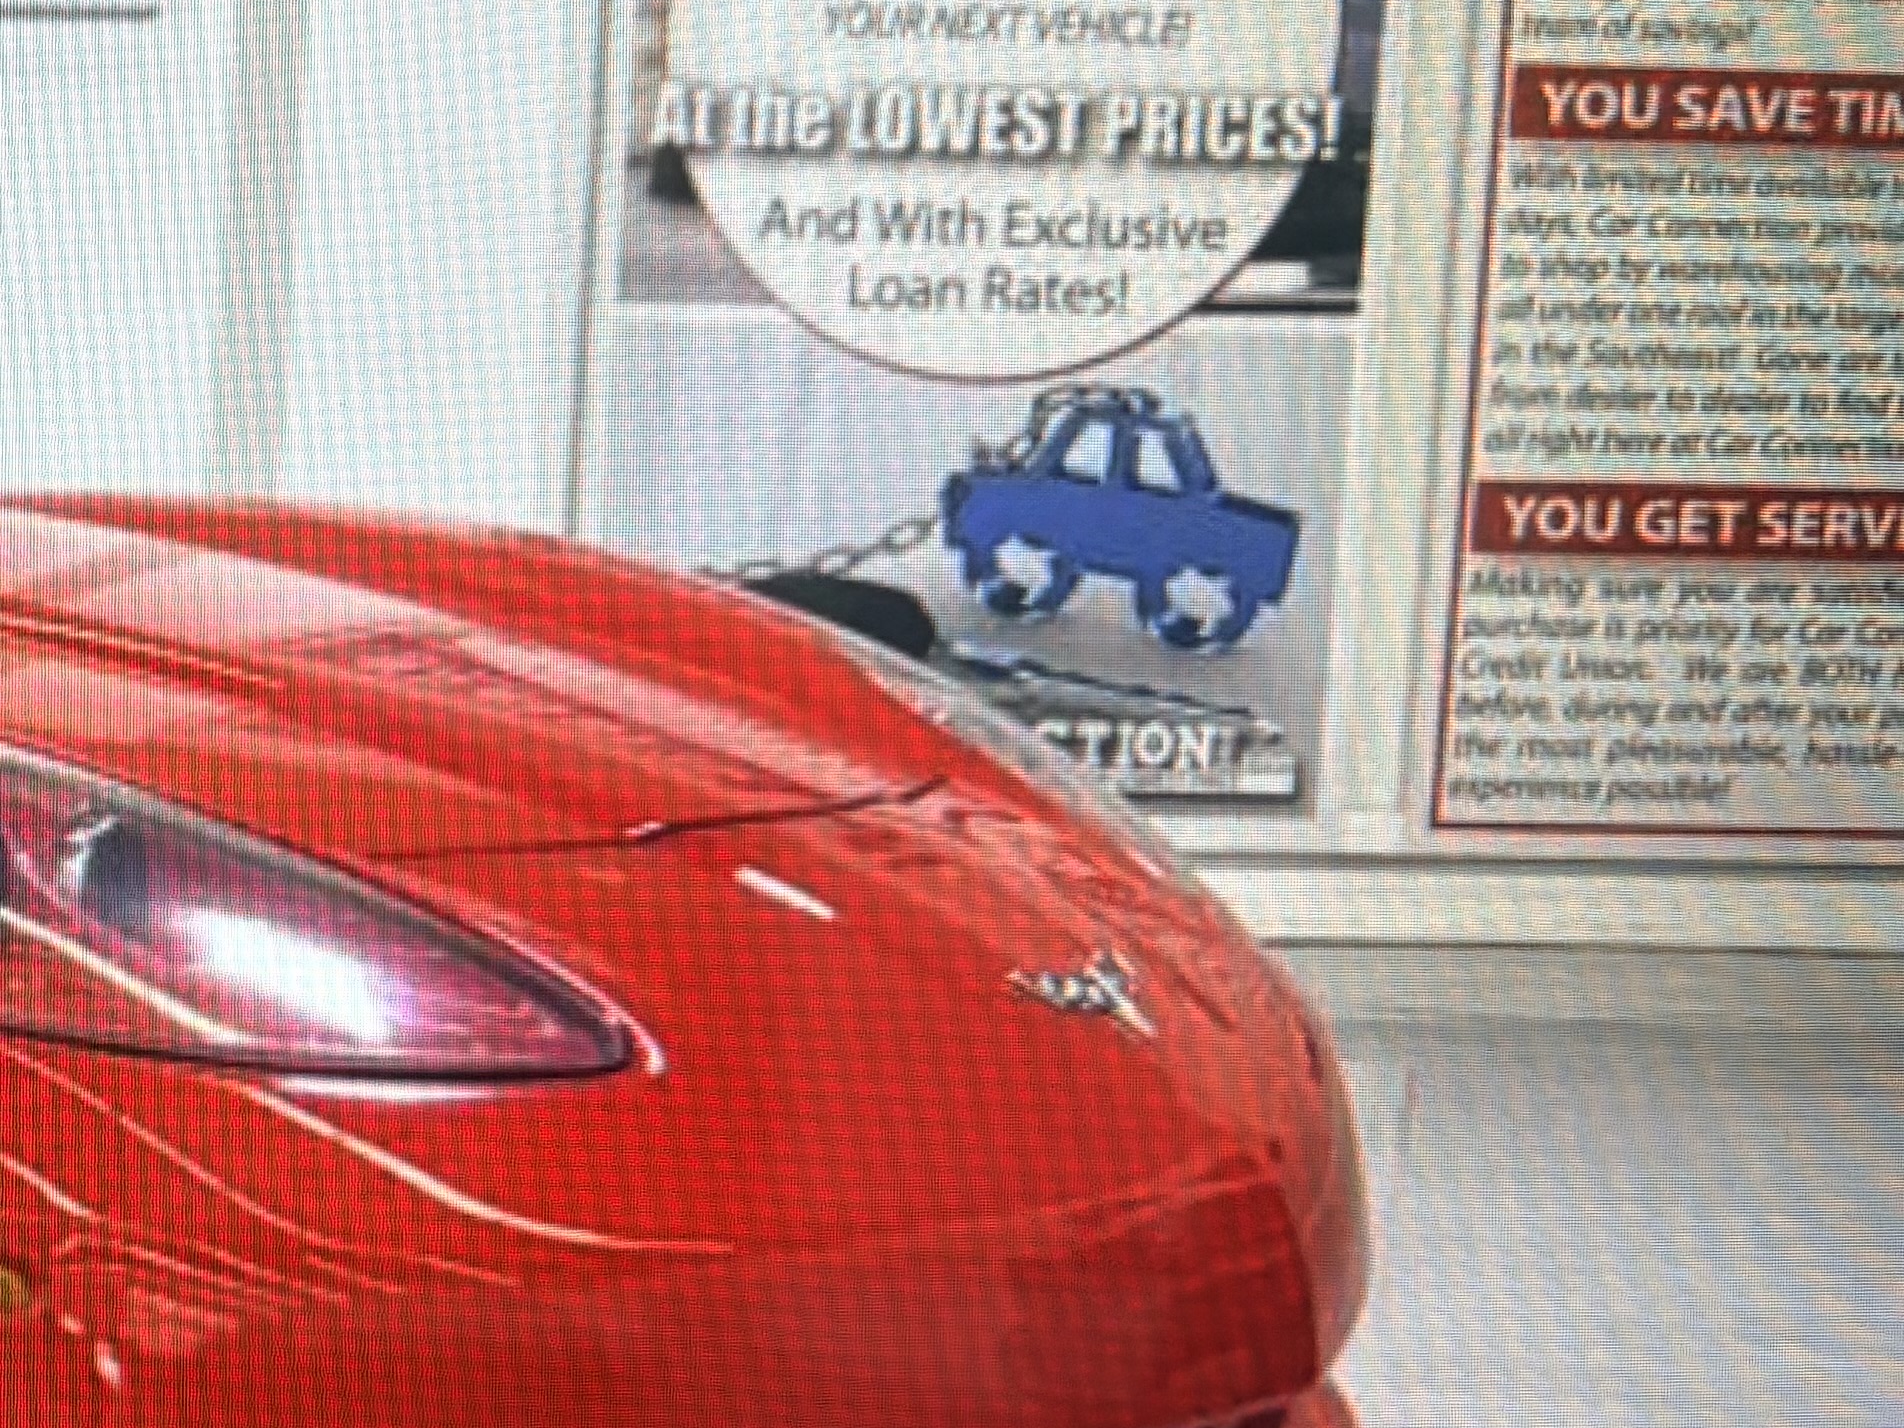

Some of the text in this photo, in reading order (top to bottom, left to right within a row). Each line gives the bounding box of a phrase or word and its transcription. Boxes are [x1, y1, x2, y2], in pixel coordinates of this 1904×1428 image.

[824, 2, 1196, 48] YOUR NEXT VEHICLE!
[651, 81, 1342, 164] At the LOWEST PRICES!
[1540, 81, 1660, 129] YOU
[1674, 84, 1817, 132] SAVE
[759, 198, 1228, 252] And With Exclusive
[848, 269, 1131, 316] Loan Rates!
[1502, 493, 1904, 549] YOU GET SERV
